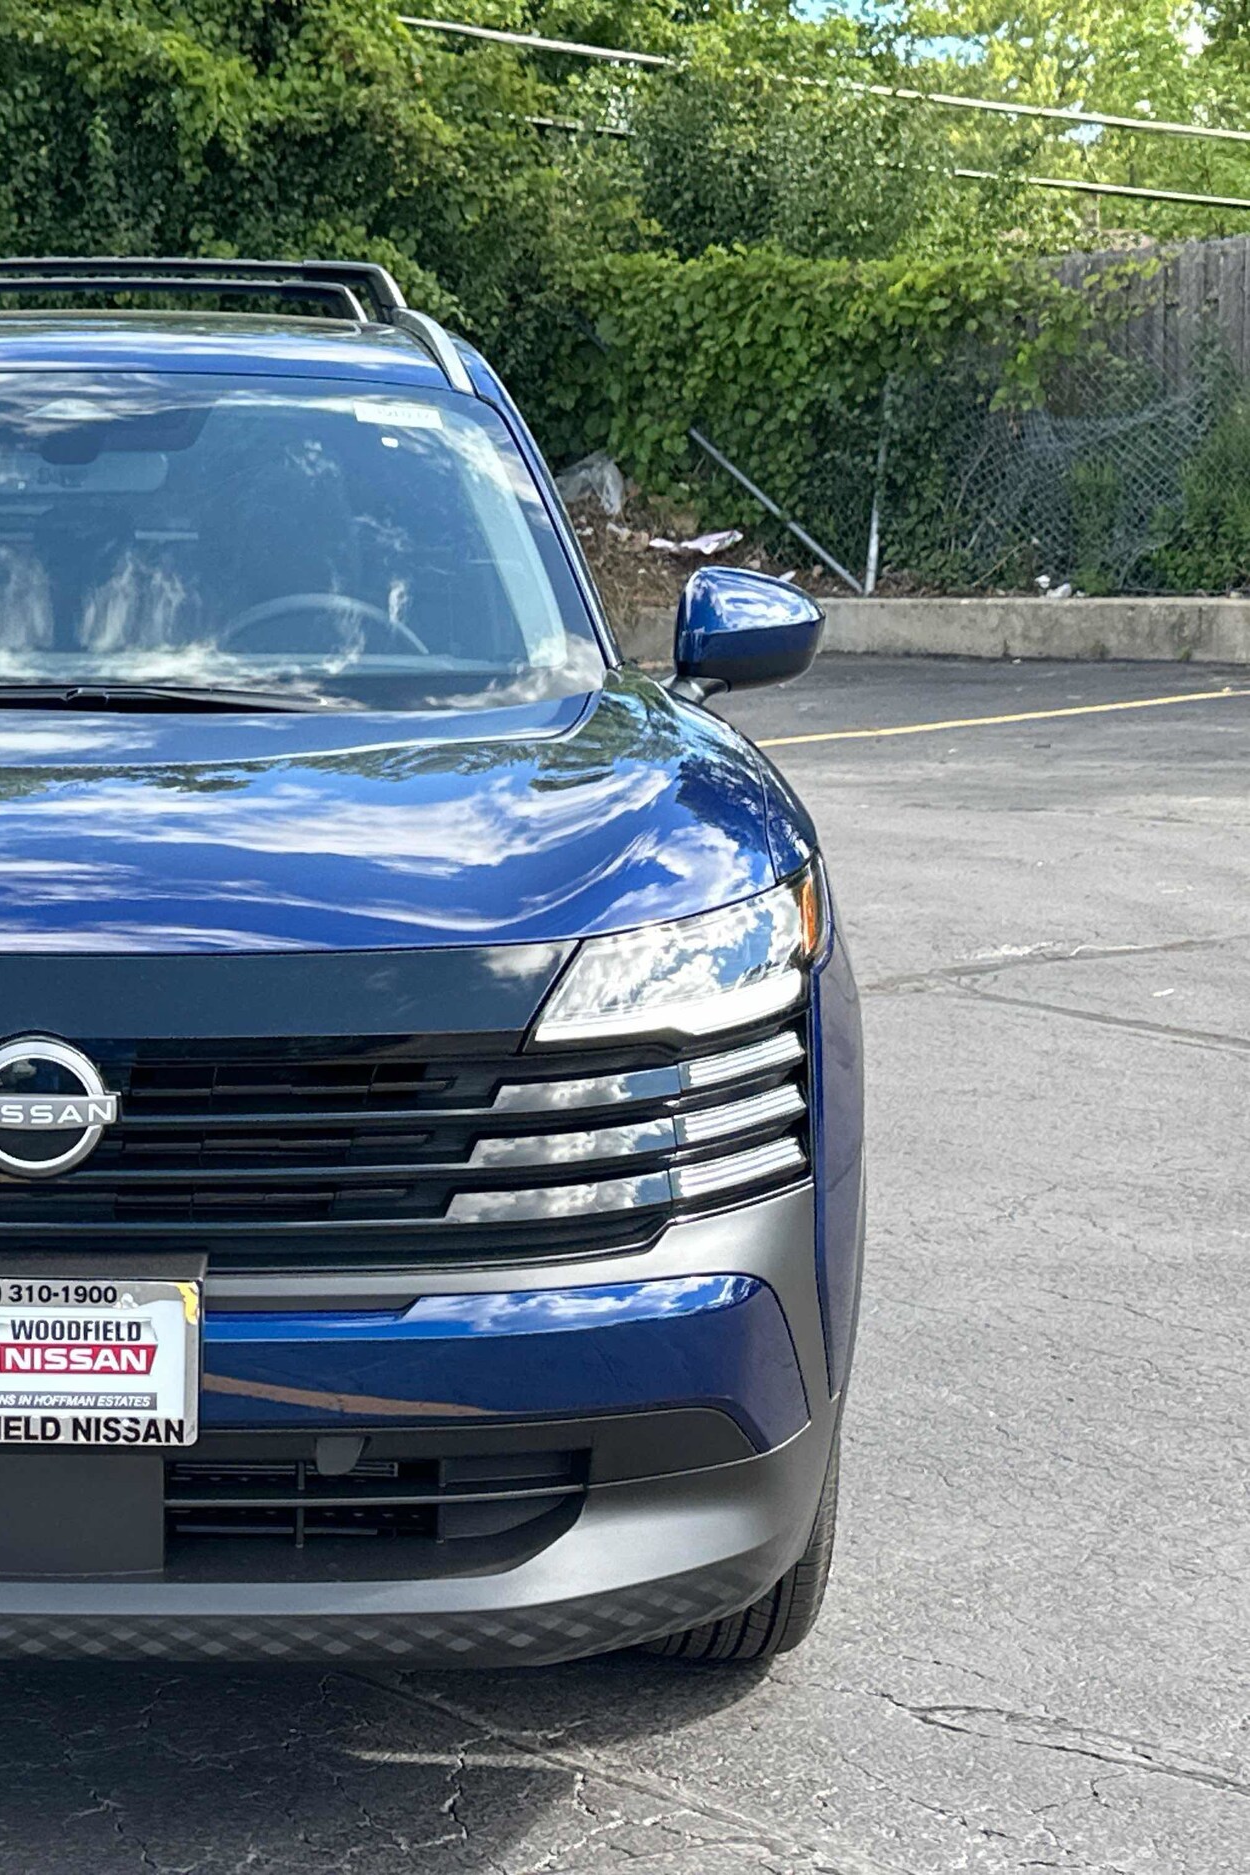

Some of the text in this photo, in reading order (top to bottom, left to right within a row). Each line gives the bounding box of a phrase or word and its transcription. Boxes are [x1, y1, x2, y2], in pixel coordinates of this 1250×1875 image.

[8, 1284, 117, 1304] 310-1900
[11, 1319, 141, 1342] WOODFIELD
[5, 1347, 147, 1371] NISSAN
[19, 1395, 31, 1406] IN
[34, 1395, 96, 1407] HOFFMAN
[99, 1396, 151, 1408] ESTATES
[72, 1416, 185, 1443] NISSAN
